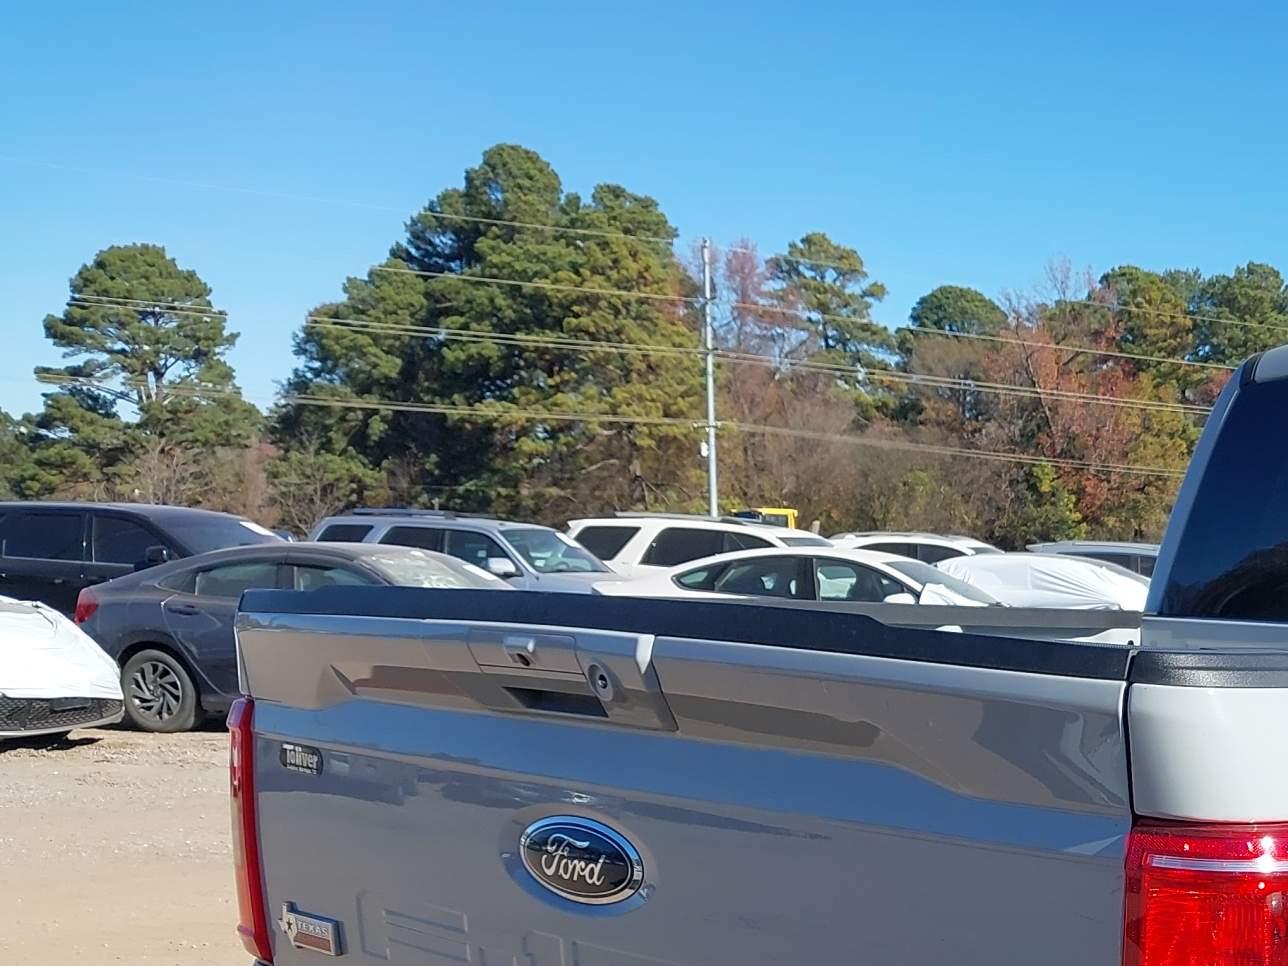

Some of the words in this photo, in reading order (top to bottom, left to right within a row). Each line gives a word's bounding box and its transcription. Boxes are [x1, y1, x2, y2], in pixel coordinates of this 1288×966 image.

[282, 743, 318, 769] Toliver
[541, 833, 605, 886] Ford
[297, 920, 329, 937] TEXAS
